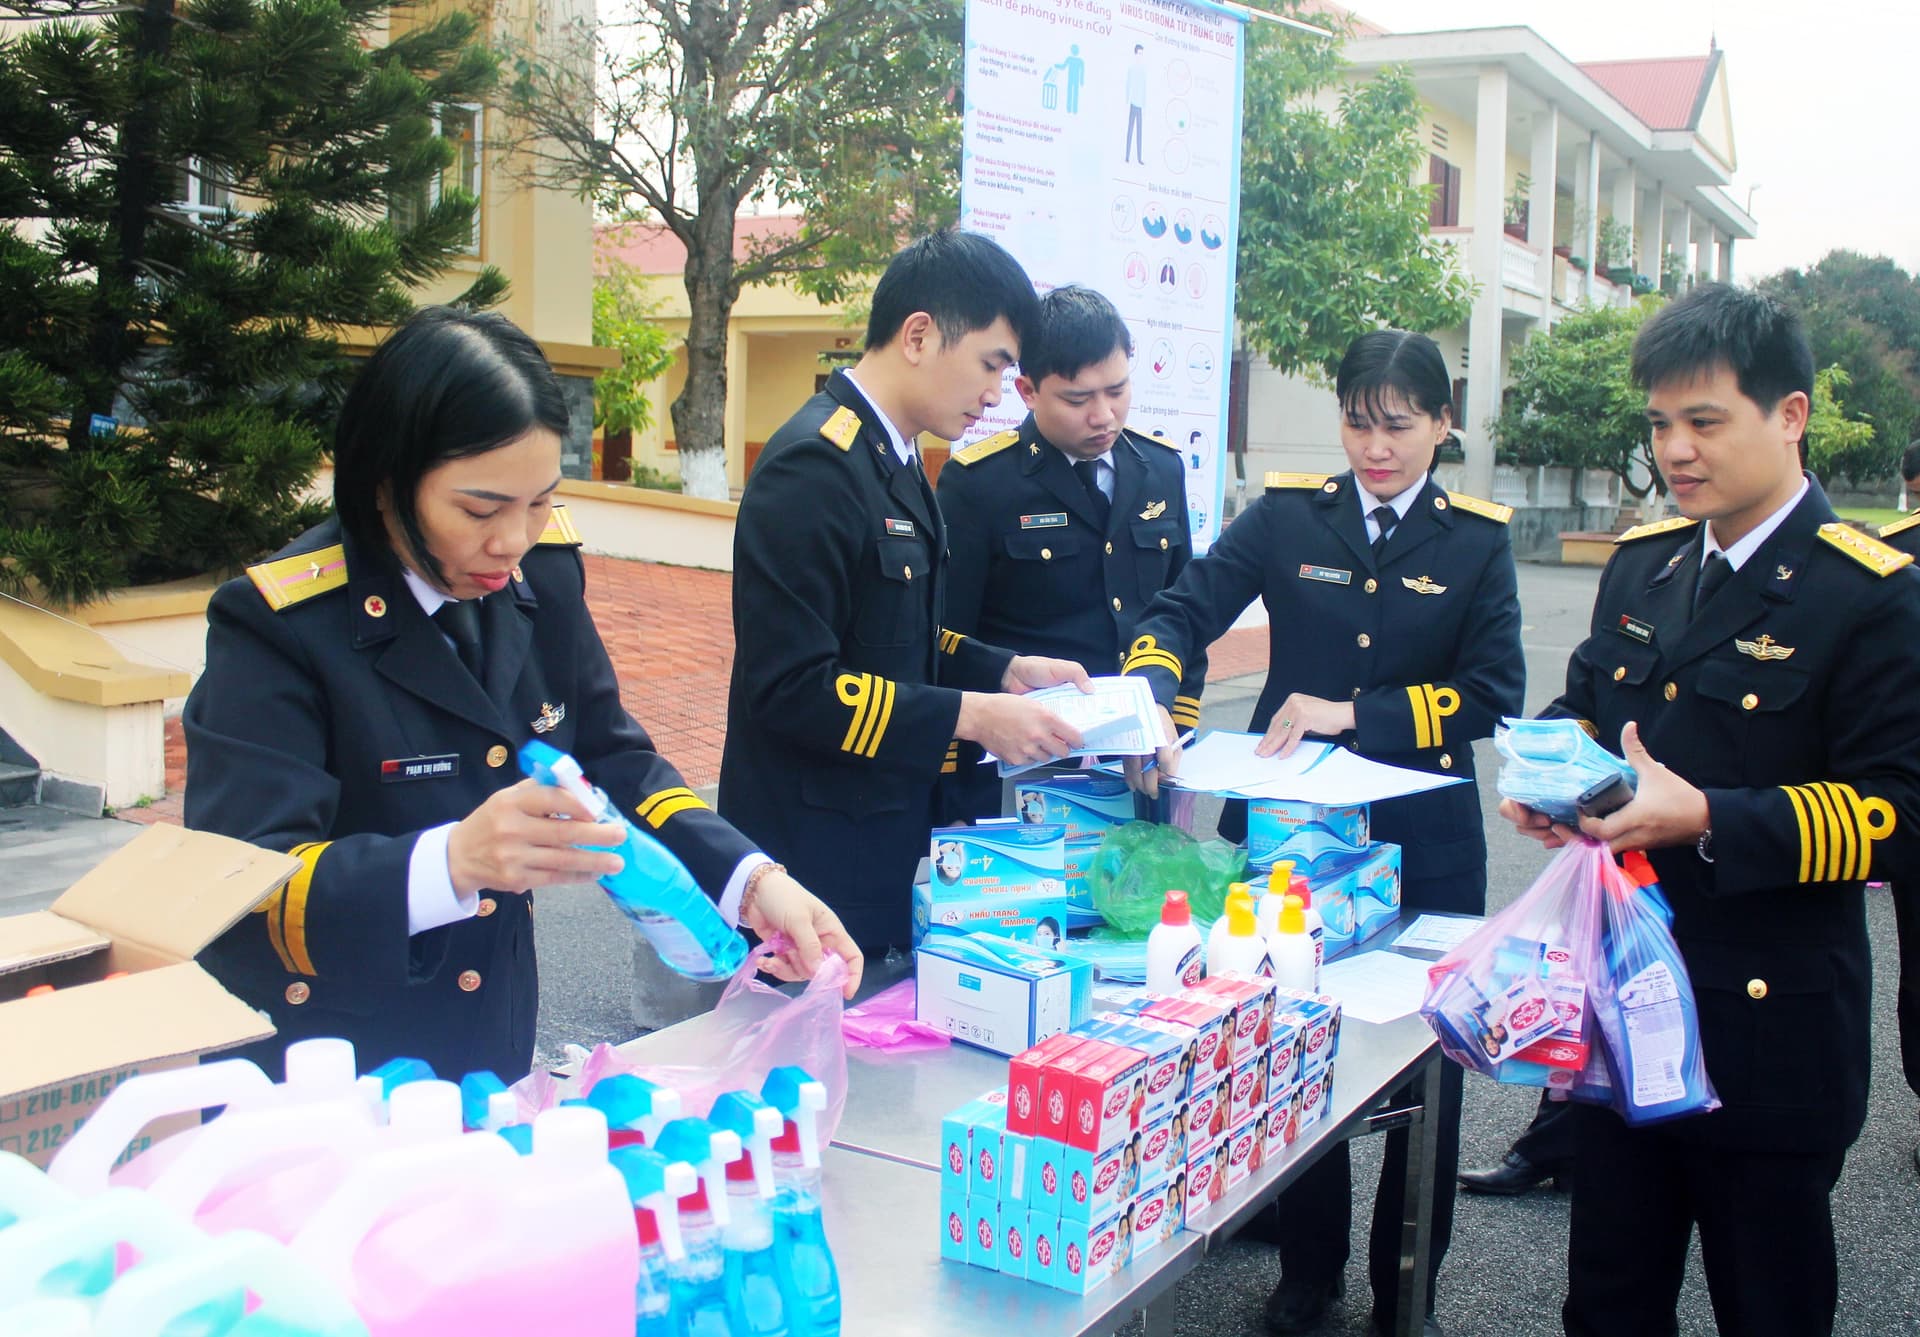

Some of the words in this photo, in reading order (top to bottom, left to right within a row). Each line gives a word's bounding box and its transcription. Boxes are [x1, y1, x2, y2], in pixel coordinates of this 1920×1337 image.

[1059, 13, 1084, 29] virus
[1086, 21, 1112, 36] nCoV
[1120, 2, 1143, 19] VIRUS
[1144, 9, 1175, 29] CORONA
[1190, 24, 1214, 40] TRUNG
[1215, 31, 1235, 47] QUỐC
[982, 855, 994, 871] 4
[969, 908, 990, 919] KHẨU
[992, 909, 1019, 919] TRANG
